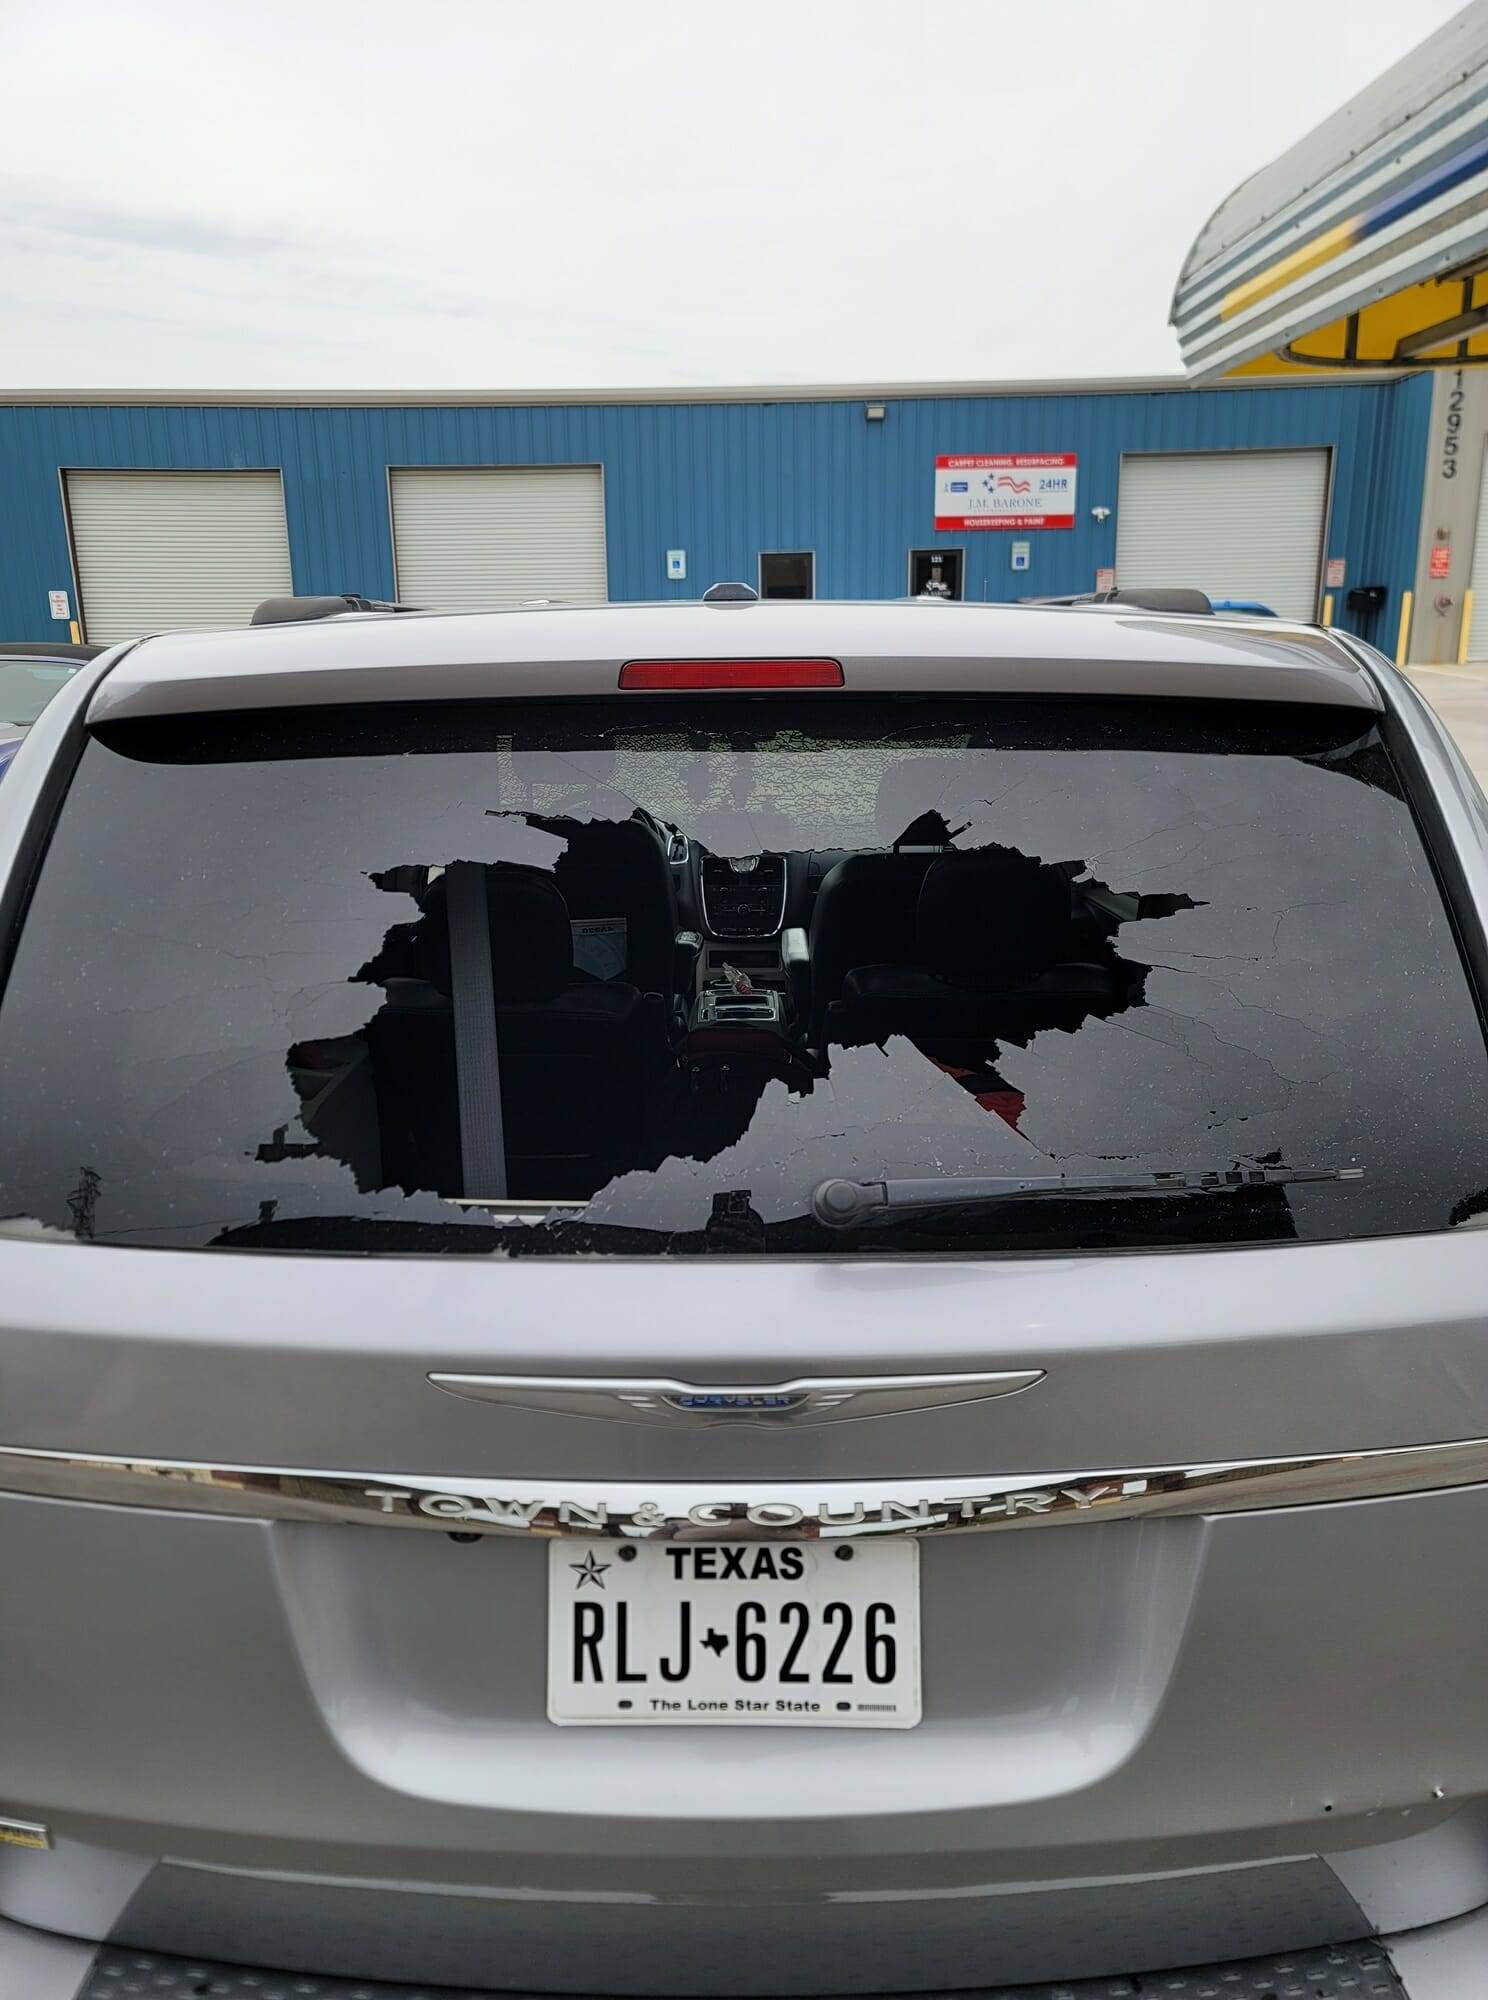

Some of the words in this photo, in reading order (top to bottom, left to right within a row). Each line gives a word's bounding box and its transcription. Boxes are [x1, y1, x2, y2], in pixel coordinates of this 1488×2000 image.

[1442, 369, 1464, 480] 12953
[948, 459, 974, 468] CARPET
[1039, 479, 1068, 490] 24HR
[992, 497, 1042, 508] BARONE
[1024, 517, 1045, 525] PAINT
[364, 1489, 609, 1525] TOWN
[630, 1501, 667, 1528] &
[686, 1487, 1119, 1527] COUNTRY
[665, 1547, 804, 1581] TEXAS
[649, 1699, 682, 1712] The
[688, 1700, 729, 1712] Lone
[734, 1700, 768, 1712] Star
[774, 1700, 821, 1713] State
